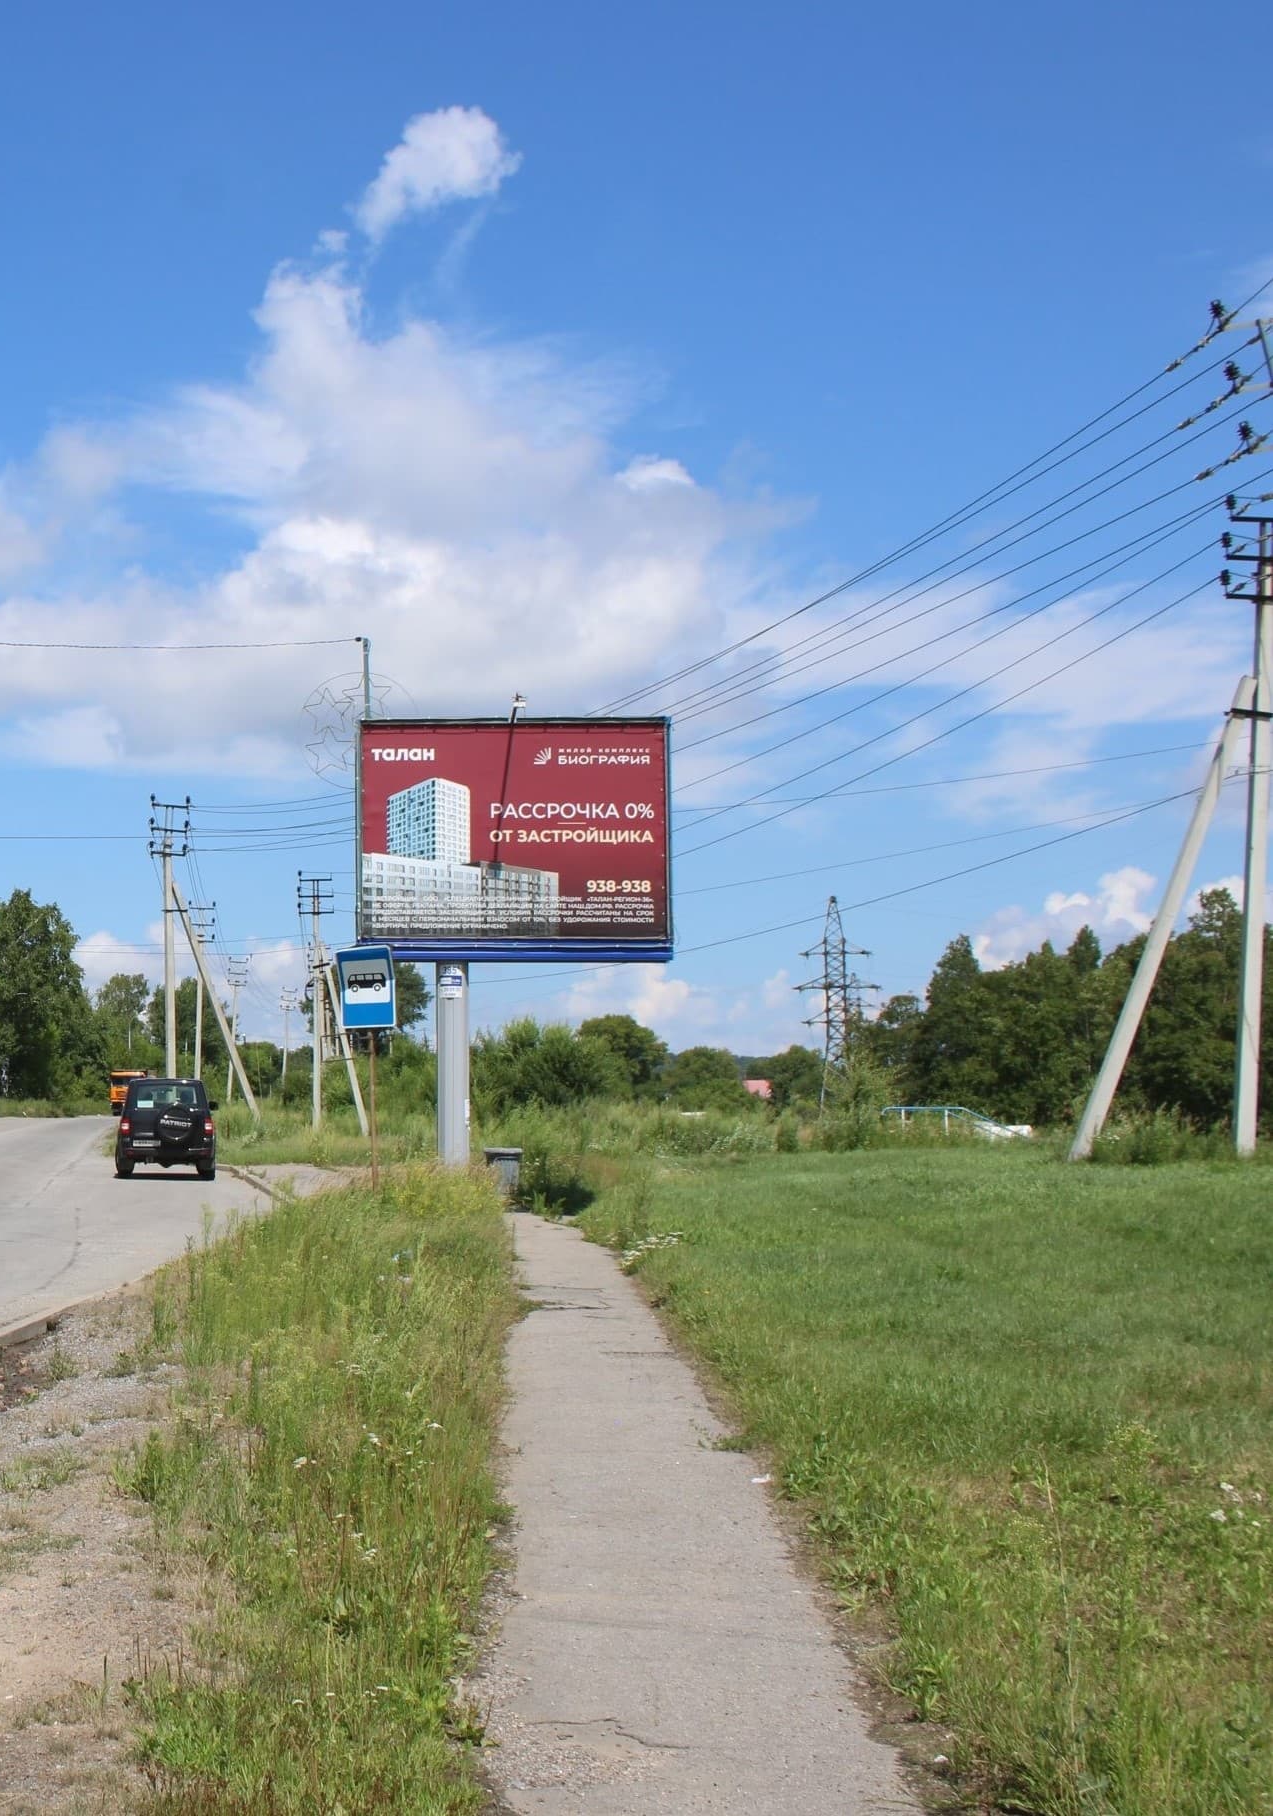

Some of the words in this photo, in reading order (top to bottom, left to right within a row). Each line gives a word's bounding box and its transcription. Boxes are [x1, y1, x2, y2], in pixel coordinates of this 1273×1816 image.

[558, 755, 651, 765] БИОГРАФИЯ
[489, 802, 620, 819] РАССРОЧКА
[624, 803, 655, 819] 0%
[489, 829, 514, 843] ОТ
[517, 827, 654, 845] ЗАСТРОЙЩИКА
[586, 880, 652, 893] 938-938
[160, 1119, 192, 1128] PATRIOT
